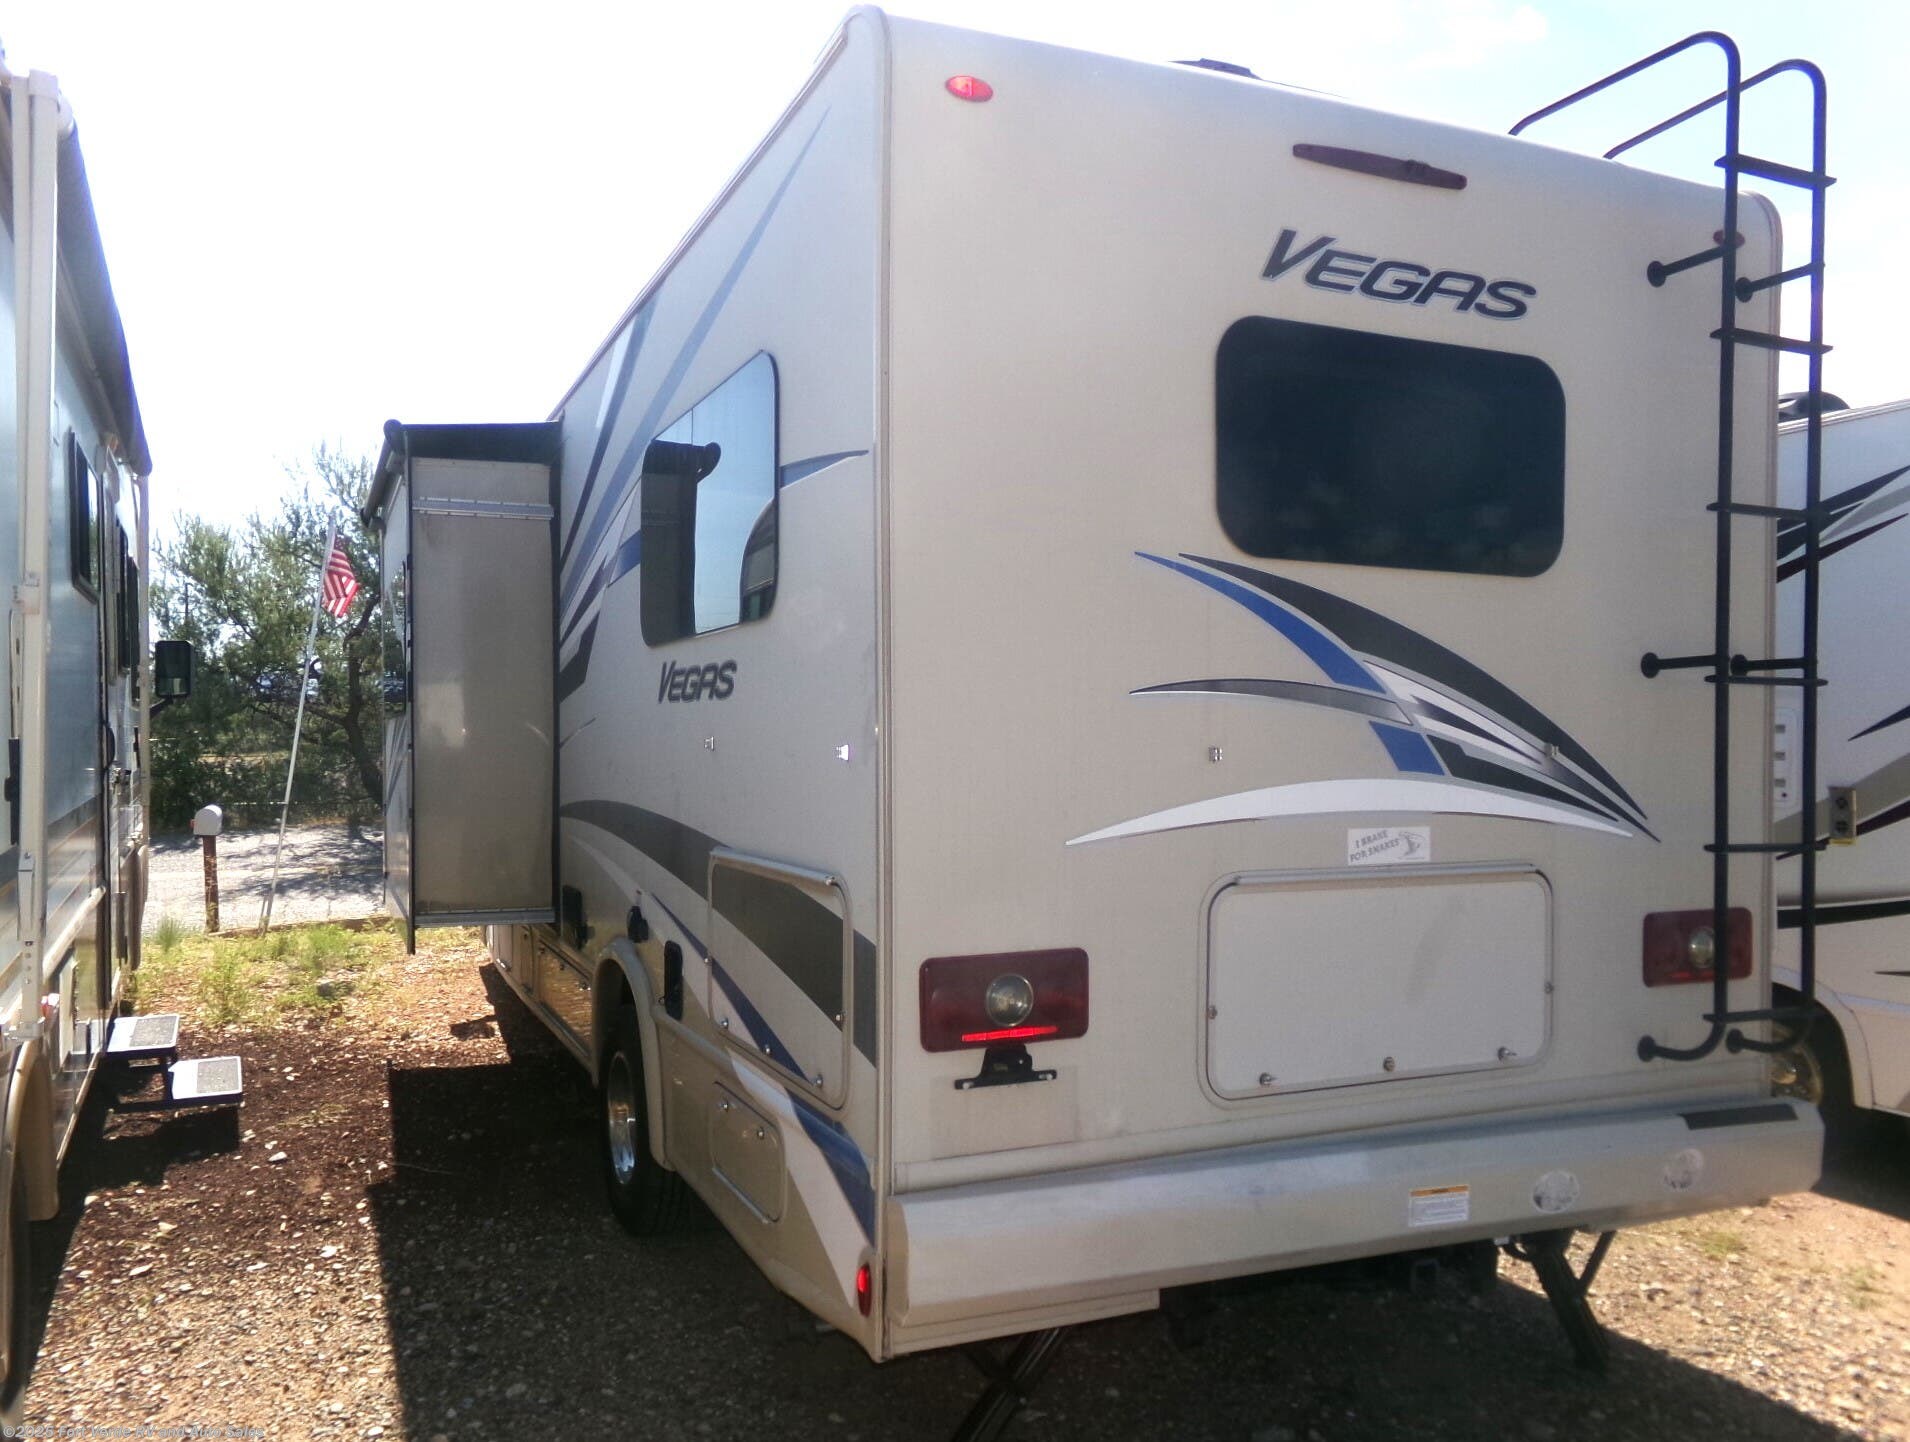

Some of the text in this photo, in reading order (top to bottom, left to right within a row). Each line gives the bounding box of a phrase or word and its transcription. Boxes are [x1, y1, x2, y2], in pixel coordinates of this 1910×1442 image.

[1261, 227, 1537, 320] VEGAS
[657, 659, 738, 704] VEGAS
[1350, 838, 1400, 862] FOR SNAKES
[1360, 829, 1388, 847] BRAKE
